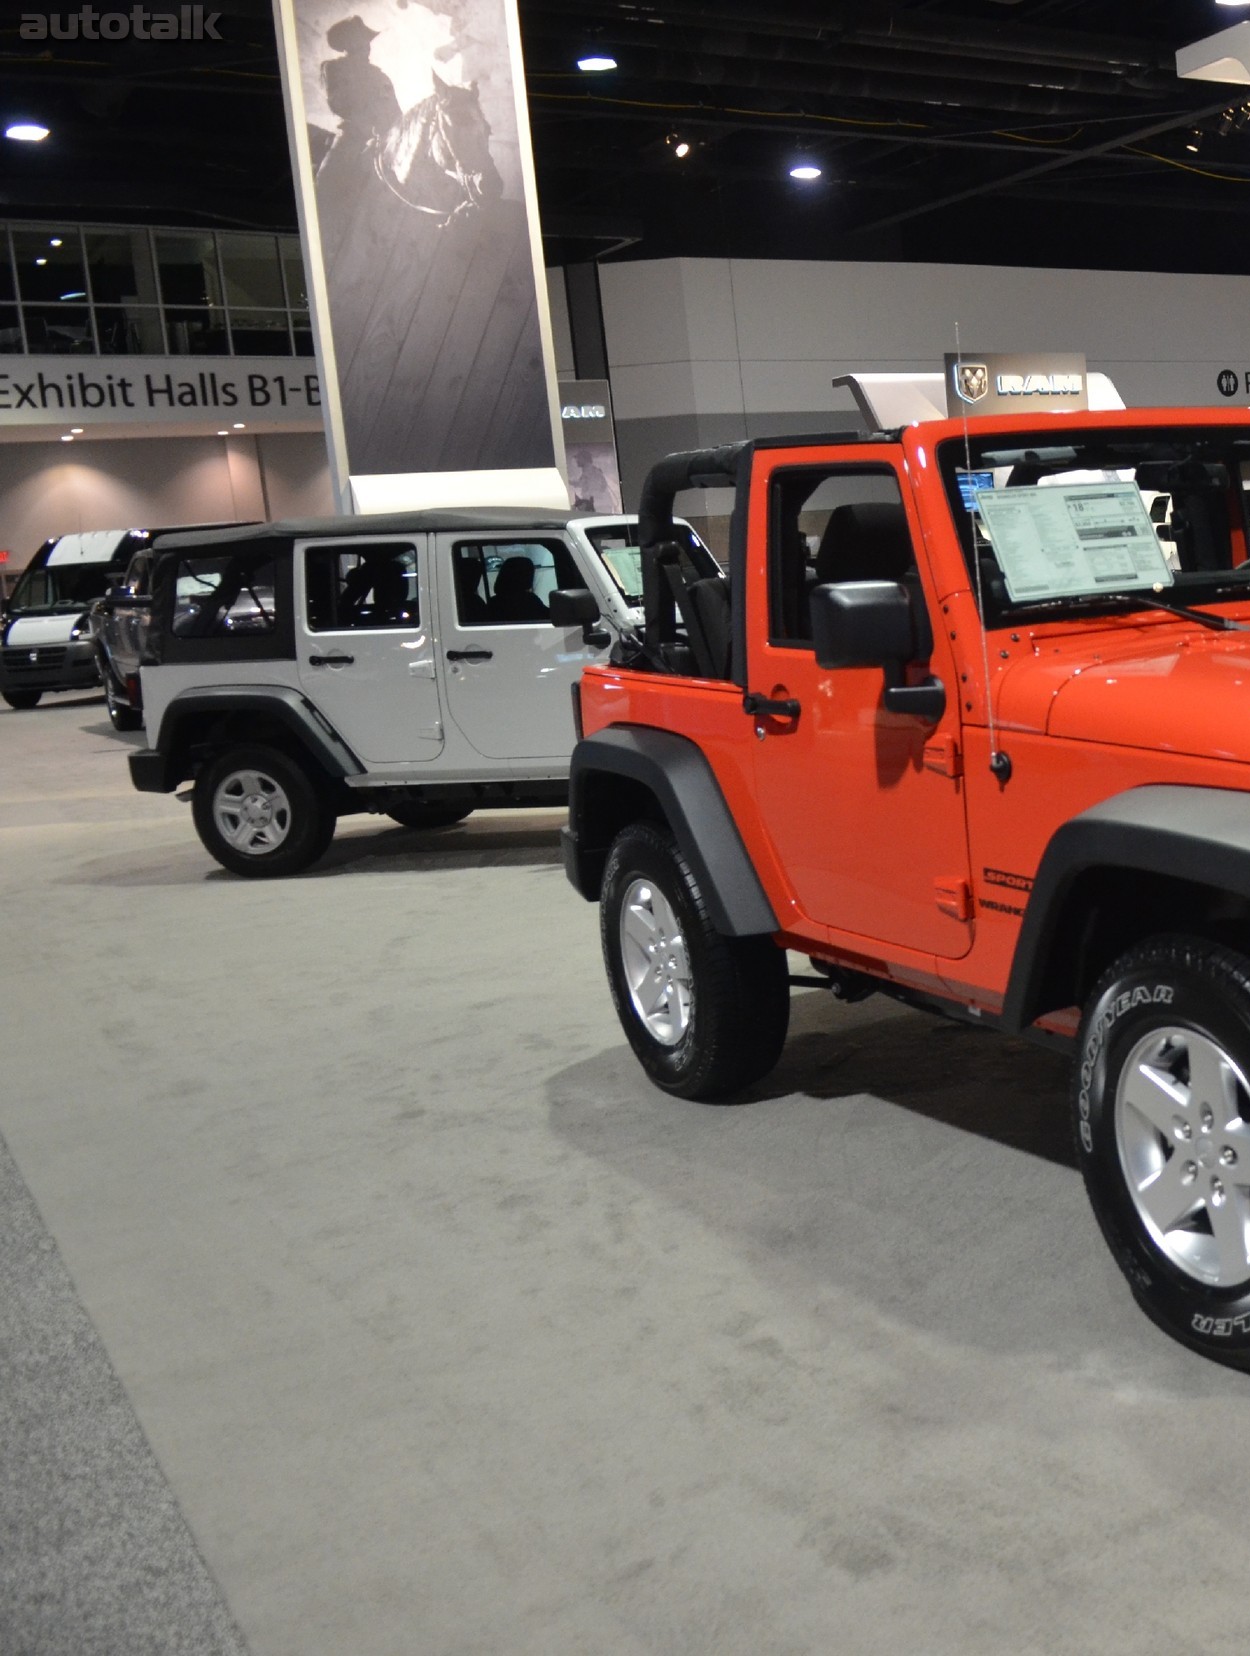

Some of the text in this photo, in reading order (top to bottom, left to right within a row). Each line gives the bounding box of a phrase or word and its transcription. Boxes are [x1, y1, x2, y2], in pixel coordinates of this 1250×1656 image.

[0, 372, 134, 408] Exhibit
[145, 373, 238, 407] Halls
[997, 375, 1082, 394] RAM
[985, 871, 1034, 890] SPORT
[1078, 984, 1175, 1153] GOODYEAR
